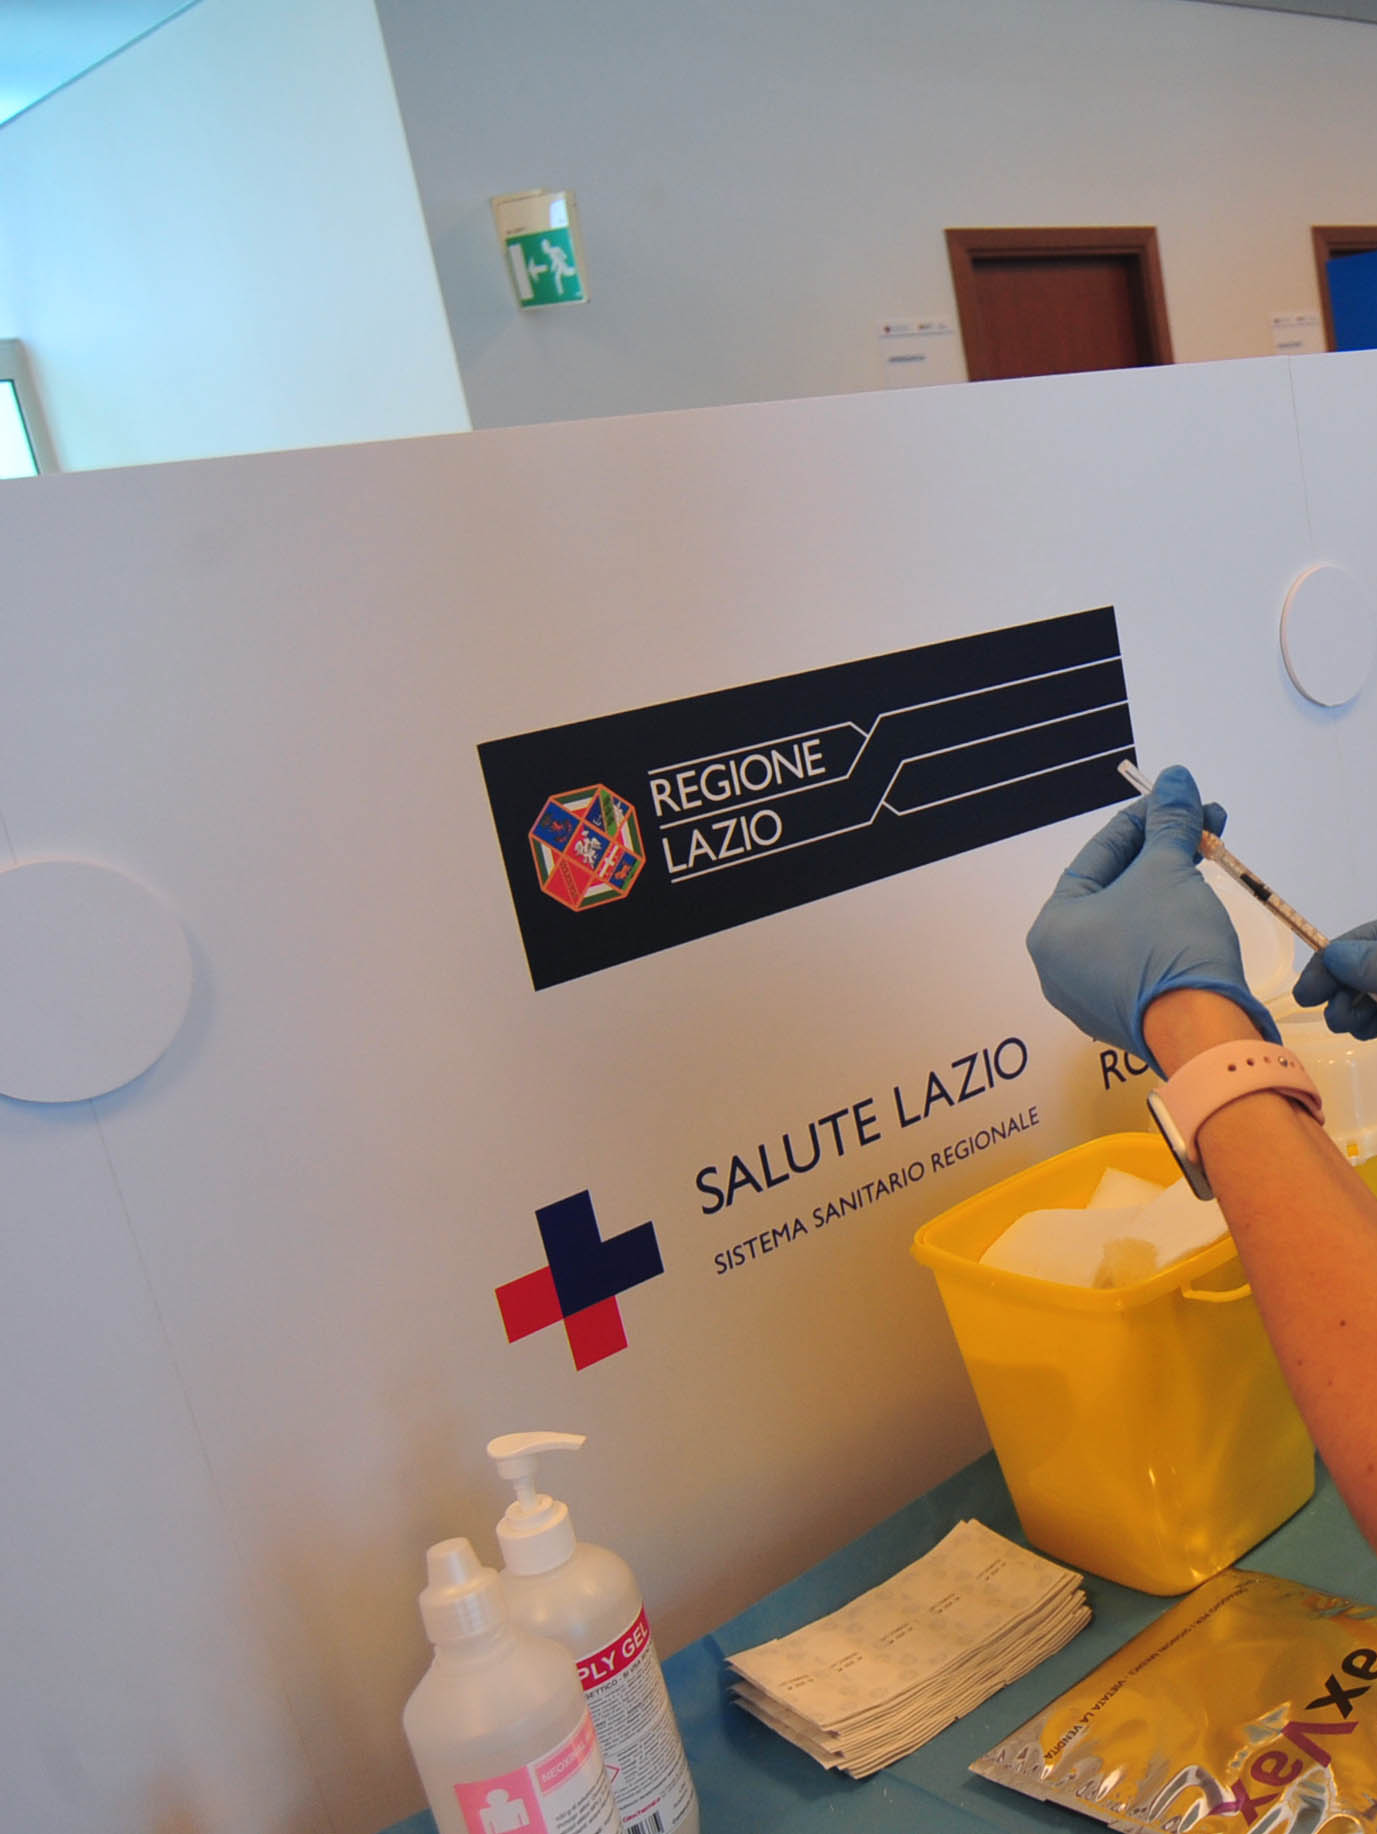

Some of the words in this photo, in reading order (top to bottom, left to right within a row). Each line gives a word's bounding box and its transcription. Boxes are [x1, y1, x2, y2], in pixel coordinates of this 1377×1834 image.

[650, 738, 827, 817] REGIONE
[662, 809, 783, 874] LAZIO
[1099, 1049, 1150, 1091] RO
[696, 1096, 882, 1215] SALUTE
[893, 1036, 1028, 1129] LAZIO
[714, 1217, 808, 1275] SISTEMA
[812, 1160, 925, 1228] SANITARIO
[930, 1105, 1040, 1173] REGIONALE
[577, 1649, 616, 1681] PLY
[621, 1621, 649, 1659] GEL
[1079, 1711, 1096, 1724] LA
[1090, 1679, 1128, 1711] VIETATA
[1043, 1724, 1083, 1760] VENDITA
